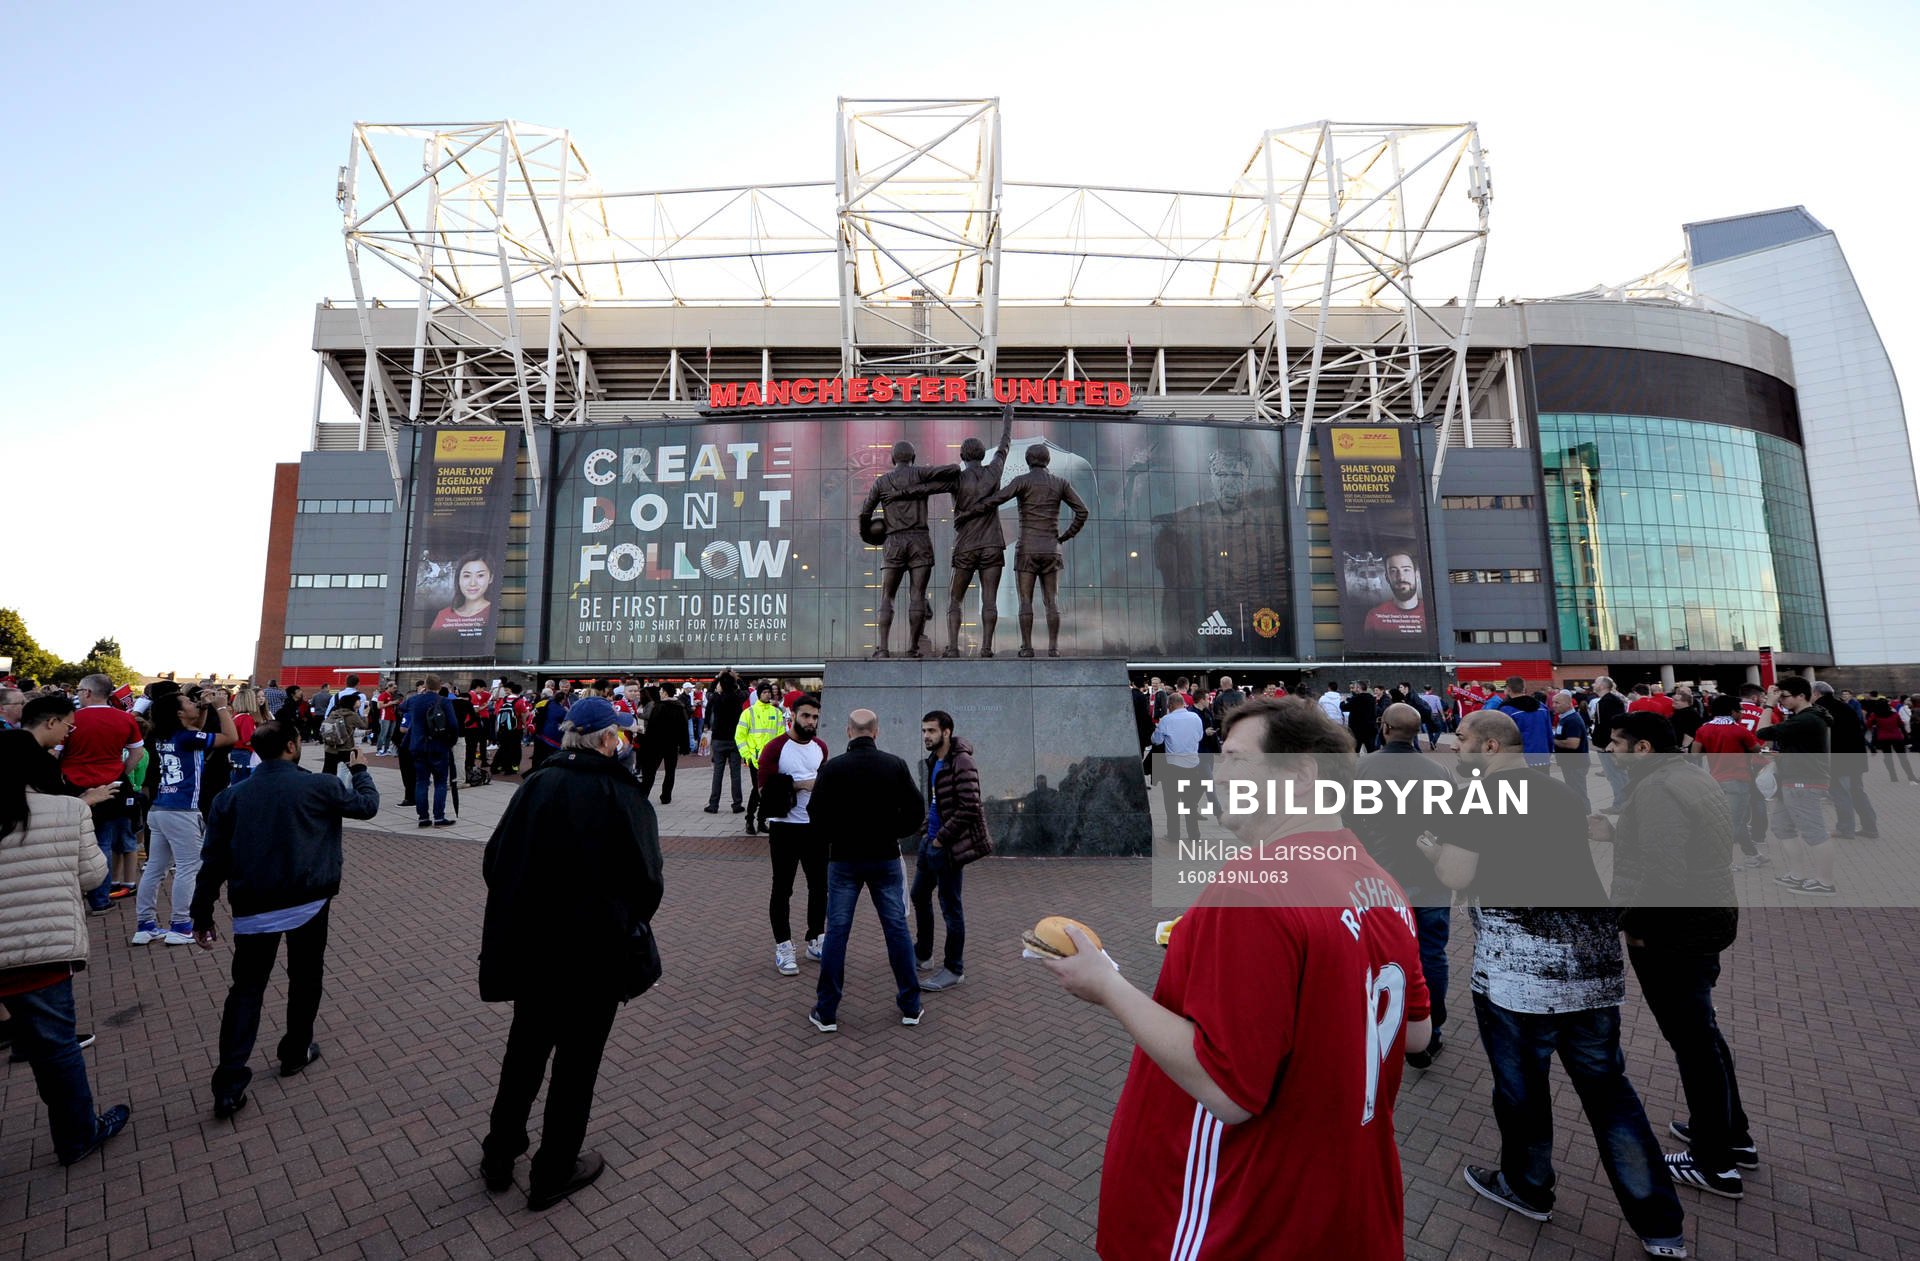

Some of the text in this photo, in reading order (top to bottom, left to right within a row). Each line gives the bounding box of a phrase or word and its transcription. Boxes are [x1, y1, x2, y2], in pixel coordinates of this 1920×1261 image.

[709, 377, 1131, 407] MANCHESTER UNITED
[583, 442, 792, 485] CREATE
[438, 467, 494, 476] SHARE YOUR
[1340, 465, 1396, 473] SHARE YOUR
[436, 477, 491, 485] LEGENDARY
[1341, 474, 1395, 483] LEGENDARY
[436, 486, 483, 495] MOMENTS
[1343, 483, 1389, 492] MOMENTS
[582, 490, 792, 533] DON'T
[579, 540, 790, 582] FOLLOW
[580, 593, 787, 619] BE FIRST TO DESIGN
[579, 618, 787, 632] UNITED'S 3RD SHIRT FOR 17/18 SEASON
[1198, 626, 1233, 635] adidas
[578, 636, 590, 644] GO
[604, 635, 616, 644] TO
